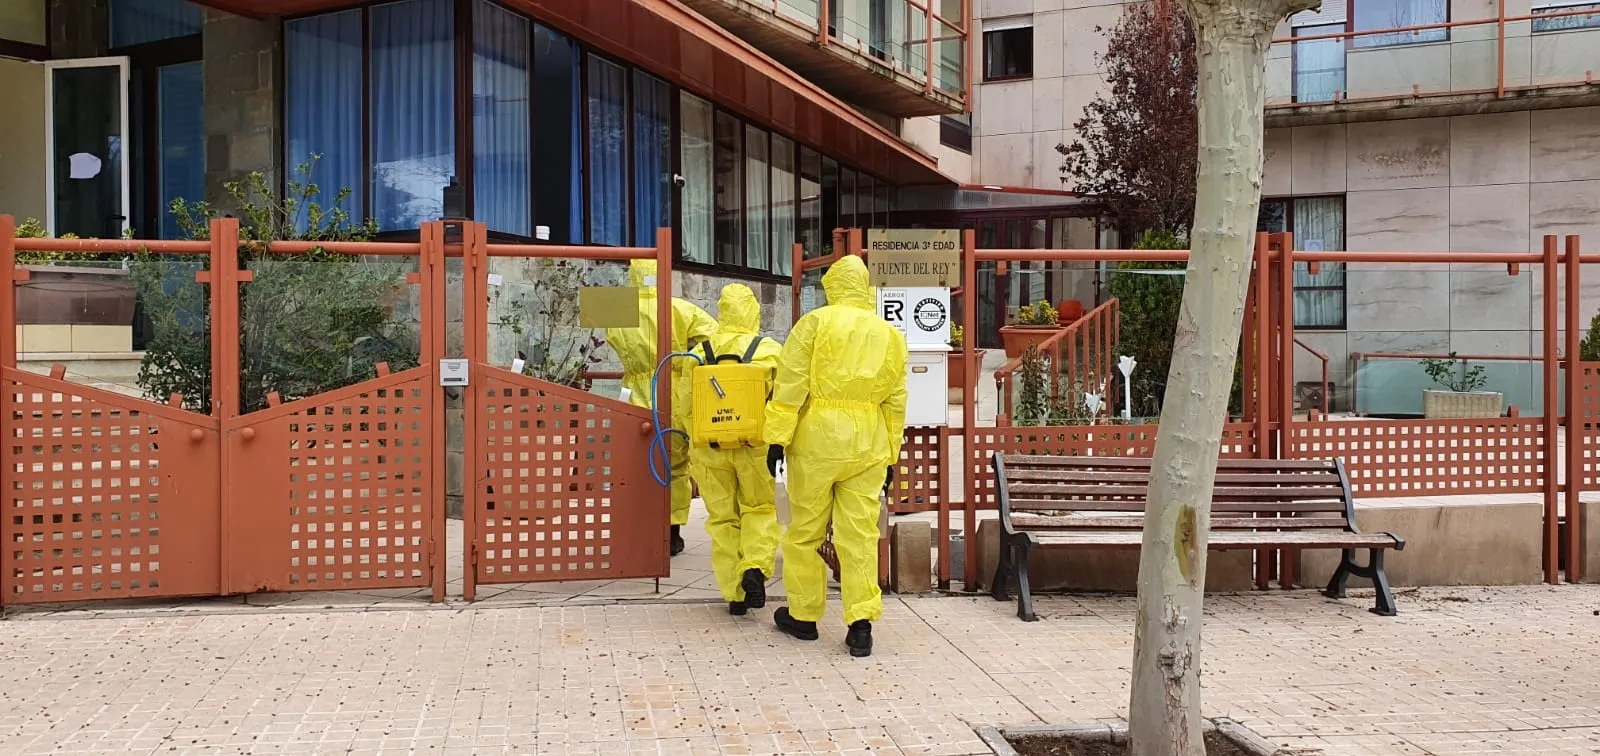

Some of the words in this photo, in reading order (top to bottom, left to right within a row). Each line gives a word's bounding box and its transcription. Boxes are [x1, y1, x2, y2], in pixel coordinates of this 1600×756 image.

[872, 241, 920, 250] RESIDENCIA
[933, 241, 955, 250] EDAD
[913, 262, 930, 275] DEL
